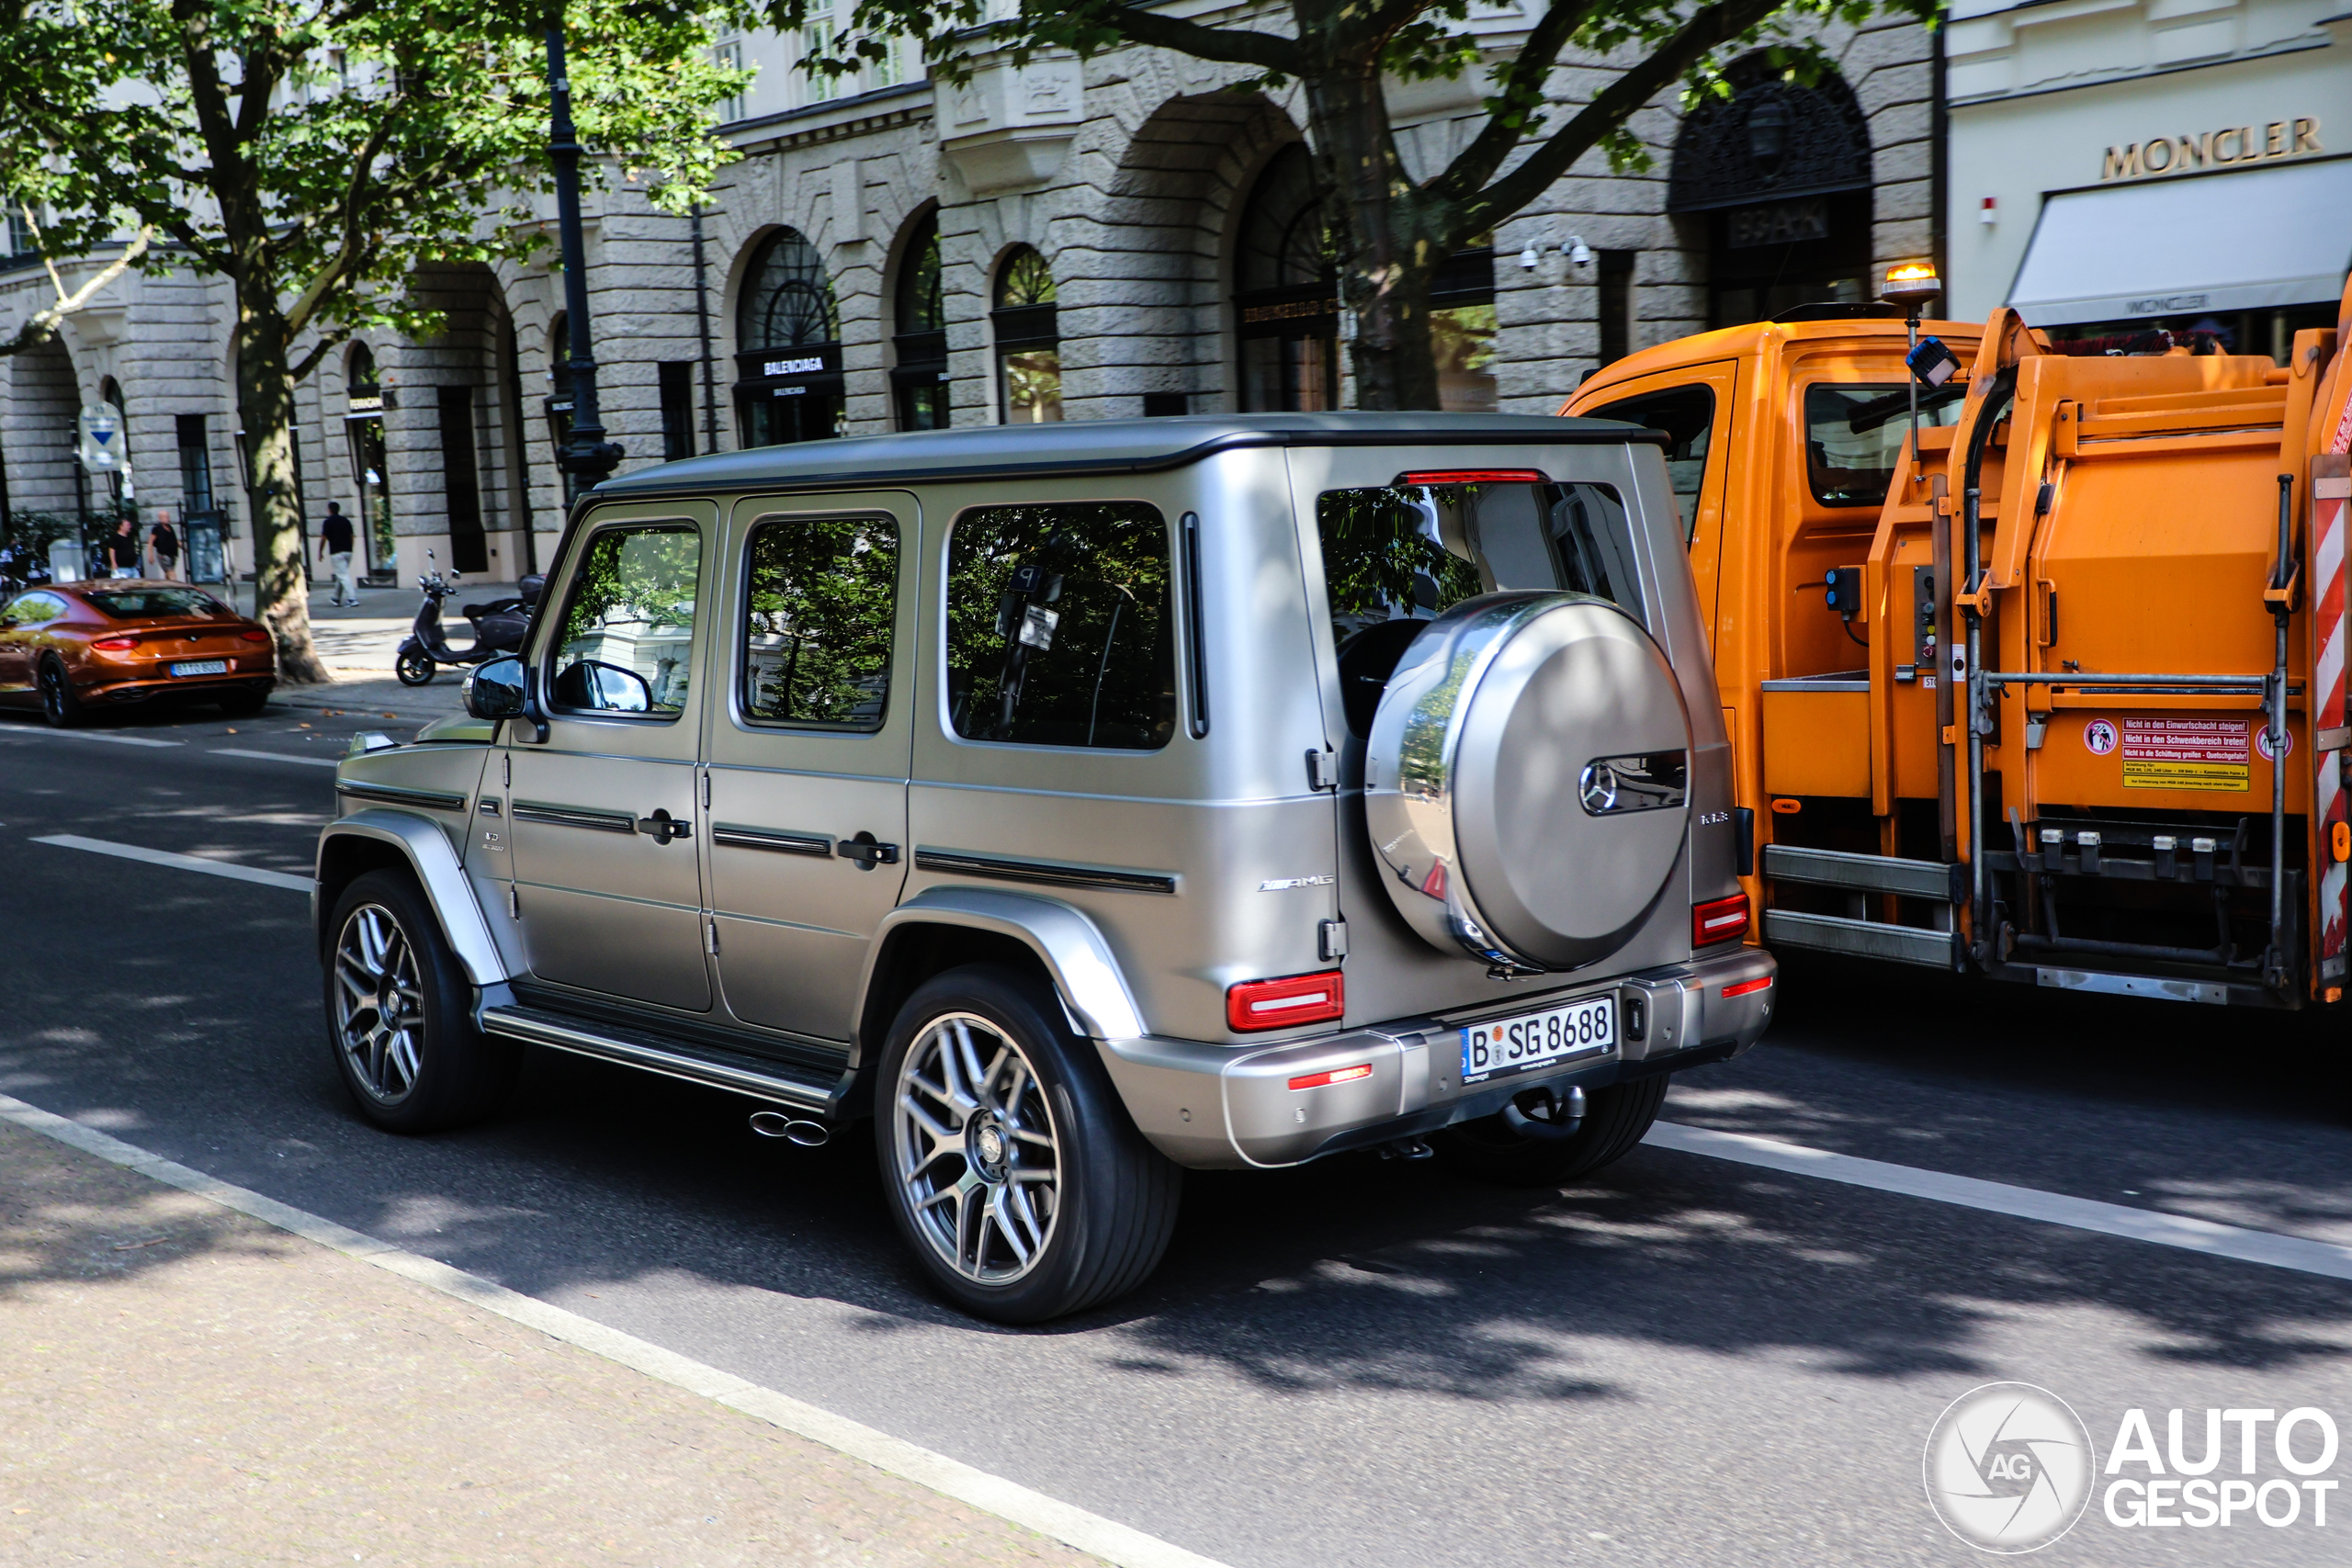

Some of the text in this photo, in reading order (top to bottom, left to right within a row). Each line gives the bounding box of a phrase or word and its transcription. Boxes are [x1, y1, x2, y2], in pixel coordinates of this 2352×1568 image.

[2102, 117, 2324, 181] MONCLER
[763, 356, 823, 377] BALENCIAGA
[2126, 720, 2245, 733] Nicht in den Einwurfschacht steigen!
[2125, 734, 2245, 746] Nicht in den Schwenkbereich treten!
[1473, 1031, 1488, 1067] B
[1509, 1020, 1541, 1059] SG
[1547, 1006, 1608, 1051] 8688
